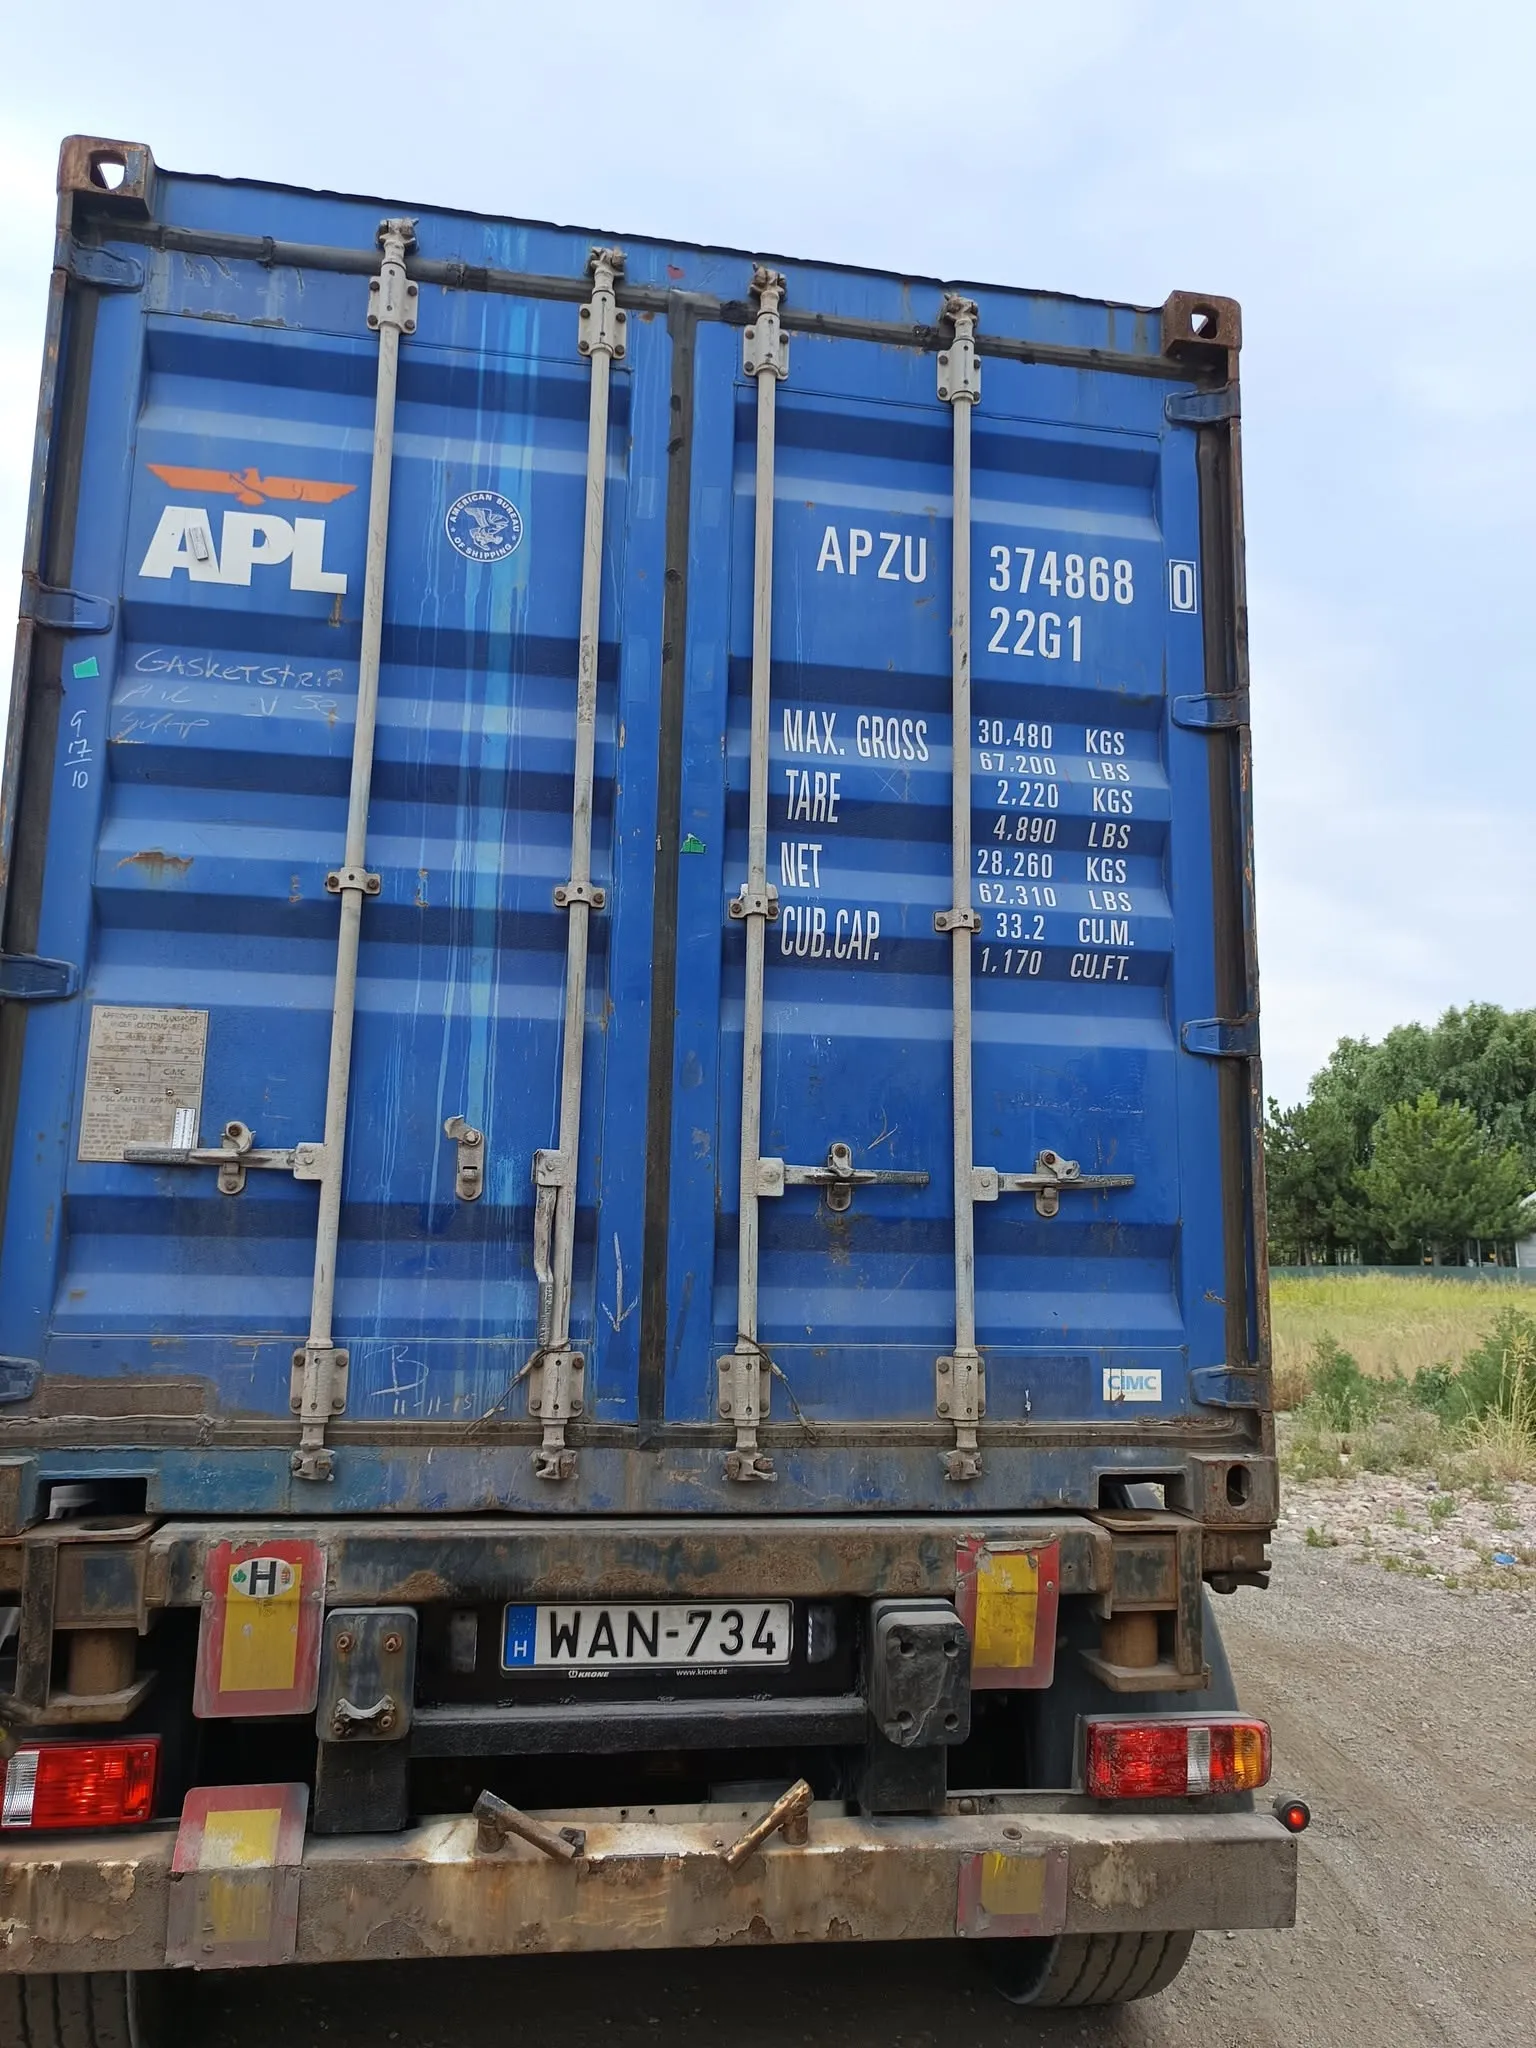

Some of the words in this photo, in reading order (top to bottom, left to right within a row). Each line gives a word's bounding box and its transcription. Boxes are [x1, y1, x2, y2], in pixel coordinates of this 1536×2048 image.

[450, 494, 492, 523] AMERICAN
[496, 498, 520, 532] BUREAU
[138, 505, 347, 594] APL
[454, 537, 465, 549] OF
[465, 543, 512, 560] SHIPPING
[816, 526, 928, 583] APZU
[988, 545, 1135, 605] 374868
[1172, 563, 1194, 611] 0
[987, 606, 1083, 662] 22G1
[68, 738, 92, 758] 17
[783, 708, 845, 756] MAX.
[856, 714, 929, 762] GROSS
[978, 719, 1053, 749] 30,480
[1085, 728, 1125, 756] KGS
[72, 770, 88, 788] 10
[1087, 761, 1130, 782] LBS
[786, 769, 840, 823] TARE
[997, 780, 1058, 809] 2,220
[1092, 787, 1133, 814] KGS
[993, 815, 1057, 844] 4,890
[1088, 822, 1131, 849] LBS
[781, 841, 822, 888] NET
[977, 849, 1053, 879] 28,260
[1086, 856, 1126, 884] KGS
[1089, 890, 1132, 912] LBS
[780, 905, 880, 960] CUB.CAP.
[996, 912, 1045, 941] 33.2
[1078, 918, 1135, 946] CU.M.
[1070, 953, 1129, 981] CU.FT.
[1107, 1375, 1157, 1390] CIMC
[249, 1561, 277, 1595] H
[513, 1640, 527, 1658] H
[549, 1609, 777, 1658] WAN-734
[676, 1668, 728, 1677] www.krone.de
